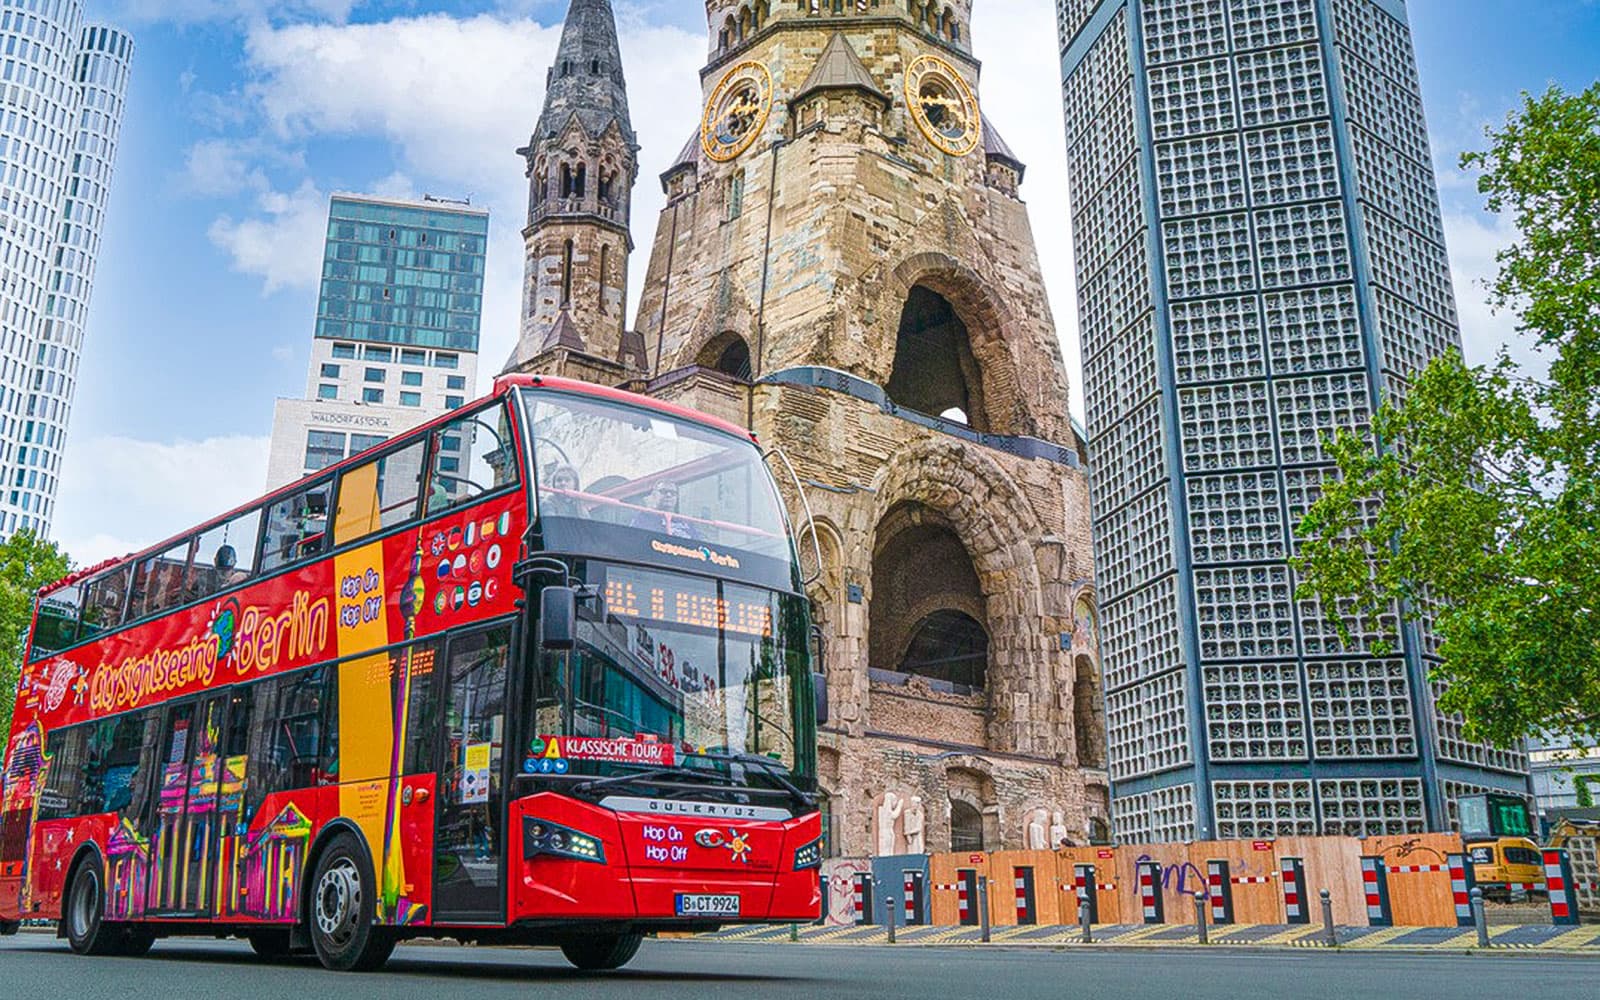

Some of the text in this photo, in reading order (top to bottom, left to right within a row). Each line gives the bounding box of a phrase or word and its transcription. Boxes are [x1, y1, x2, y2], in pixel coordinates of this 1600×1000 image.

[340, 567, 379, 599] Hop On
[339, 595, 382, 629] Hop Off
[236, 590, 328, 676] Berlin
[566, 739, 628, 756] KLASSISCHE
[643, 825, 683, 841] Hop On
[646, 845, 688, 861] Hop Off
